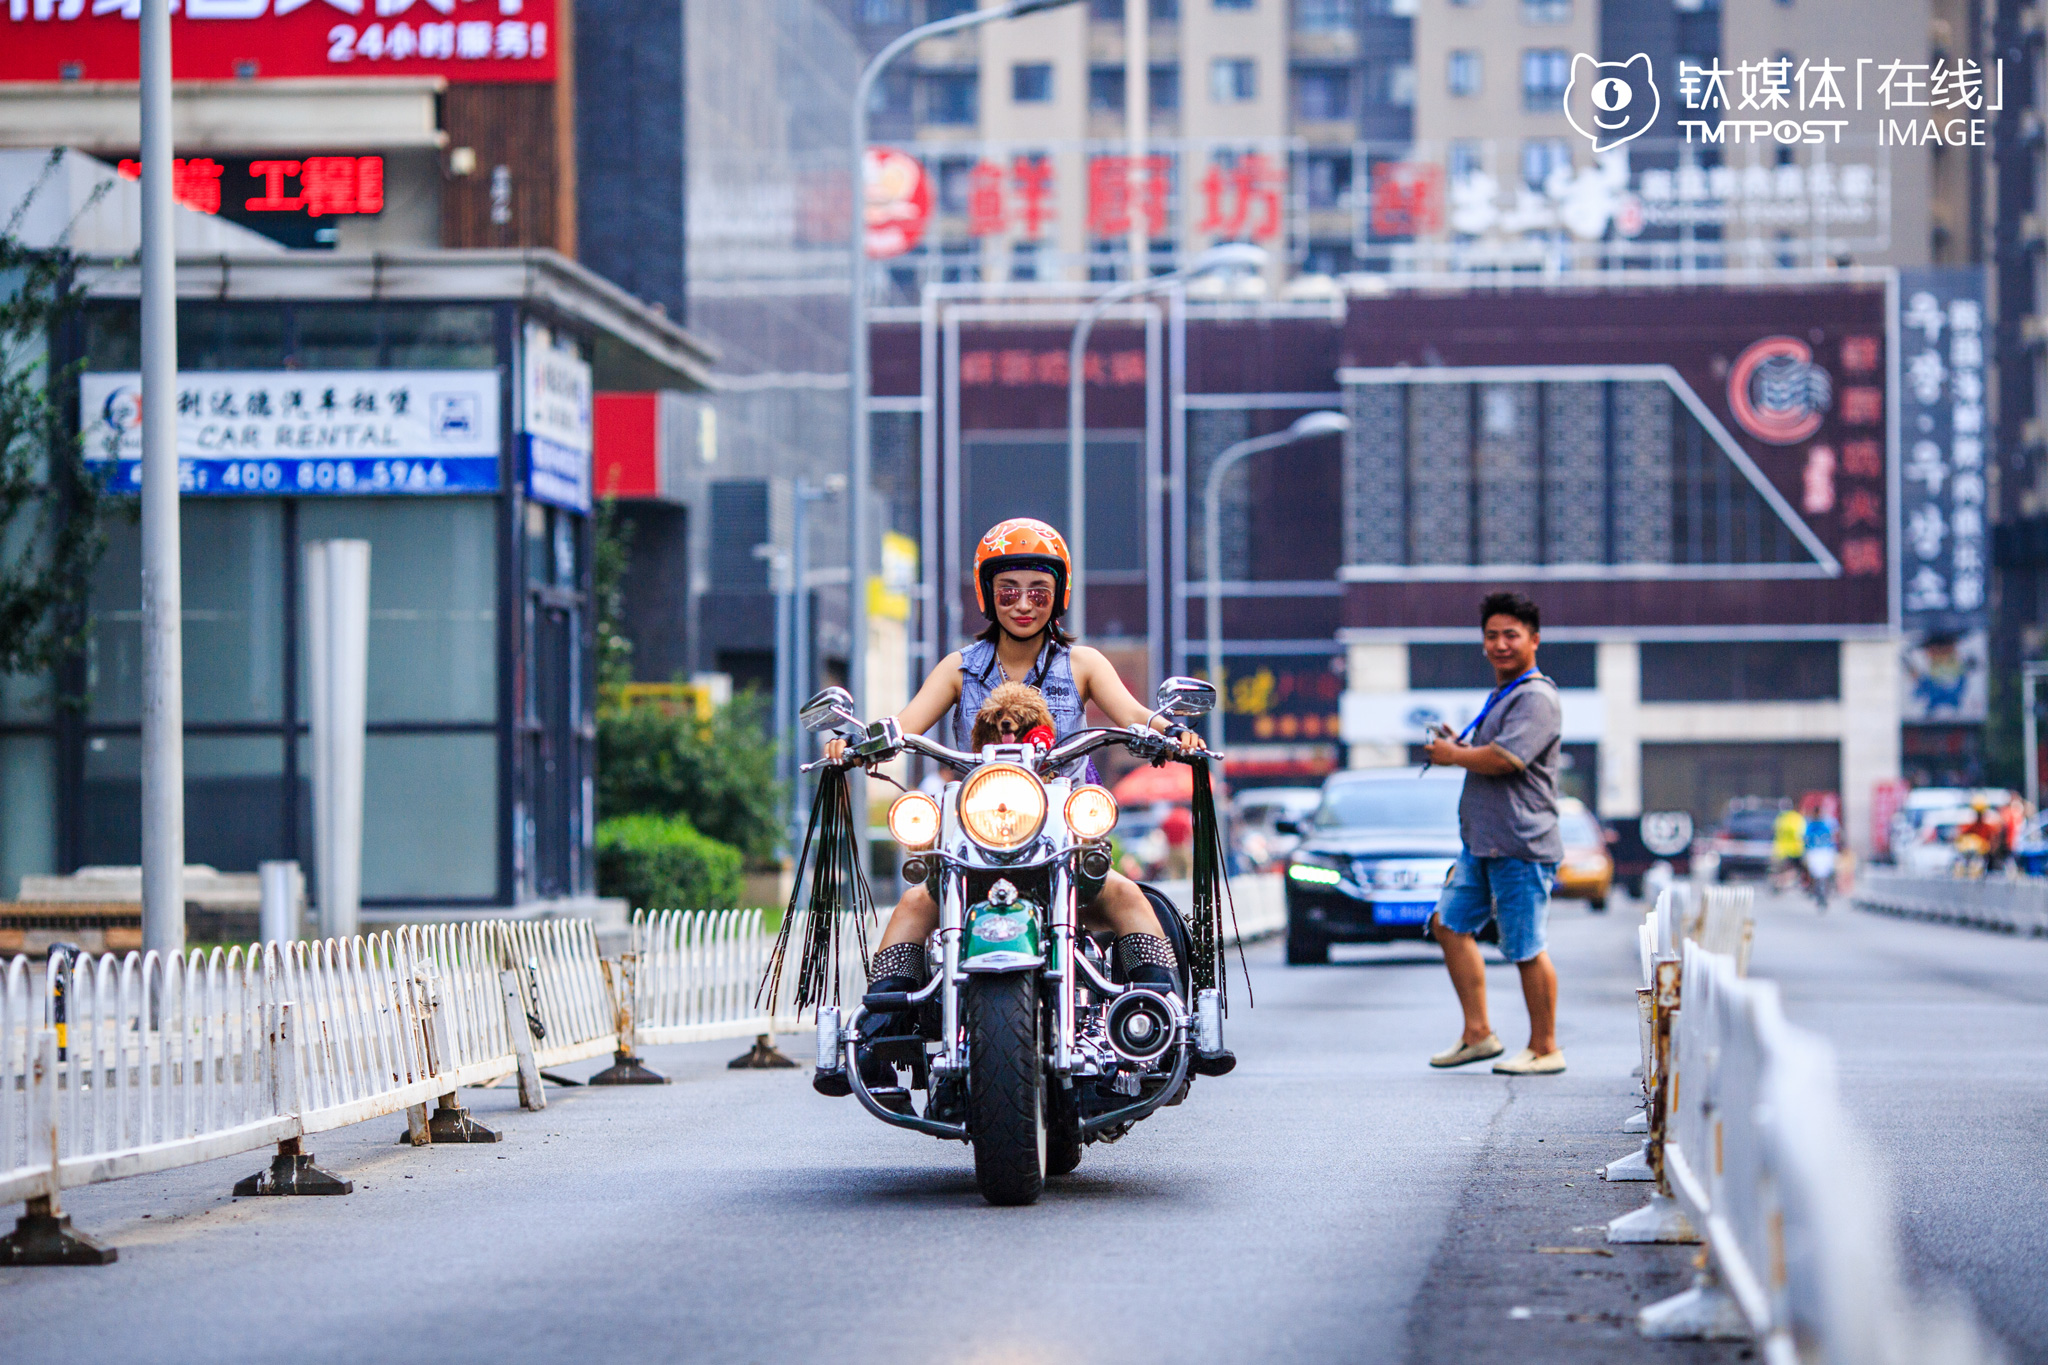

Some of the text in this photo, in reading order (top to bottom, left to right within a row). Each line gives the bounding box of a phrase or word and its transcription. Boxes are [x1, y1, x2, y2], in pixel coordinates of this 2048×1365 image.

[327, 20, 548, 63] 24小时服务!
[966, 153, 1286, 243] 鲜厨坊
[197, 422, 400, 450] CAR RENTAL
[222, 461, 282, 490] 400
[298, 460, 356, 490] 808
